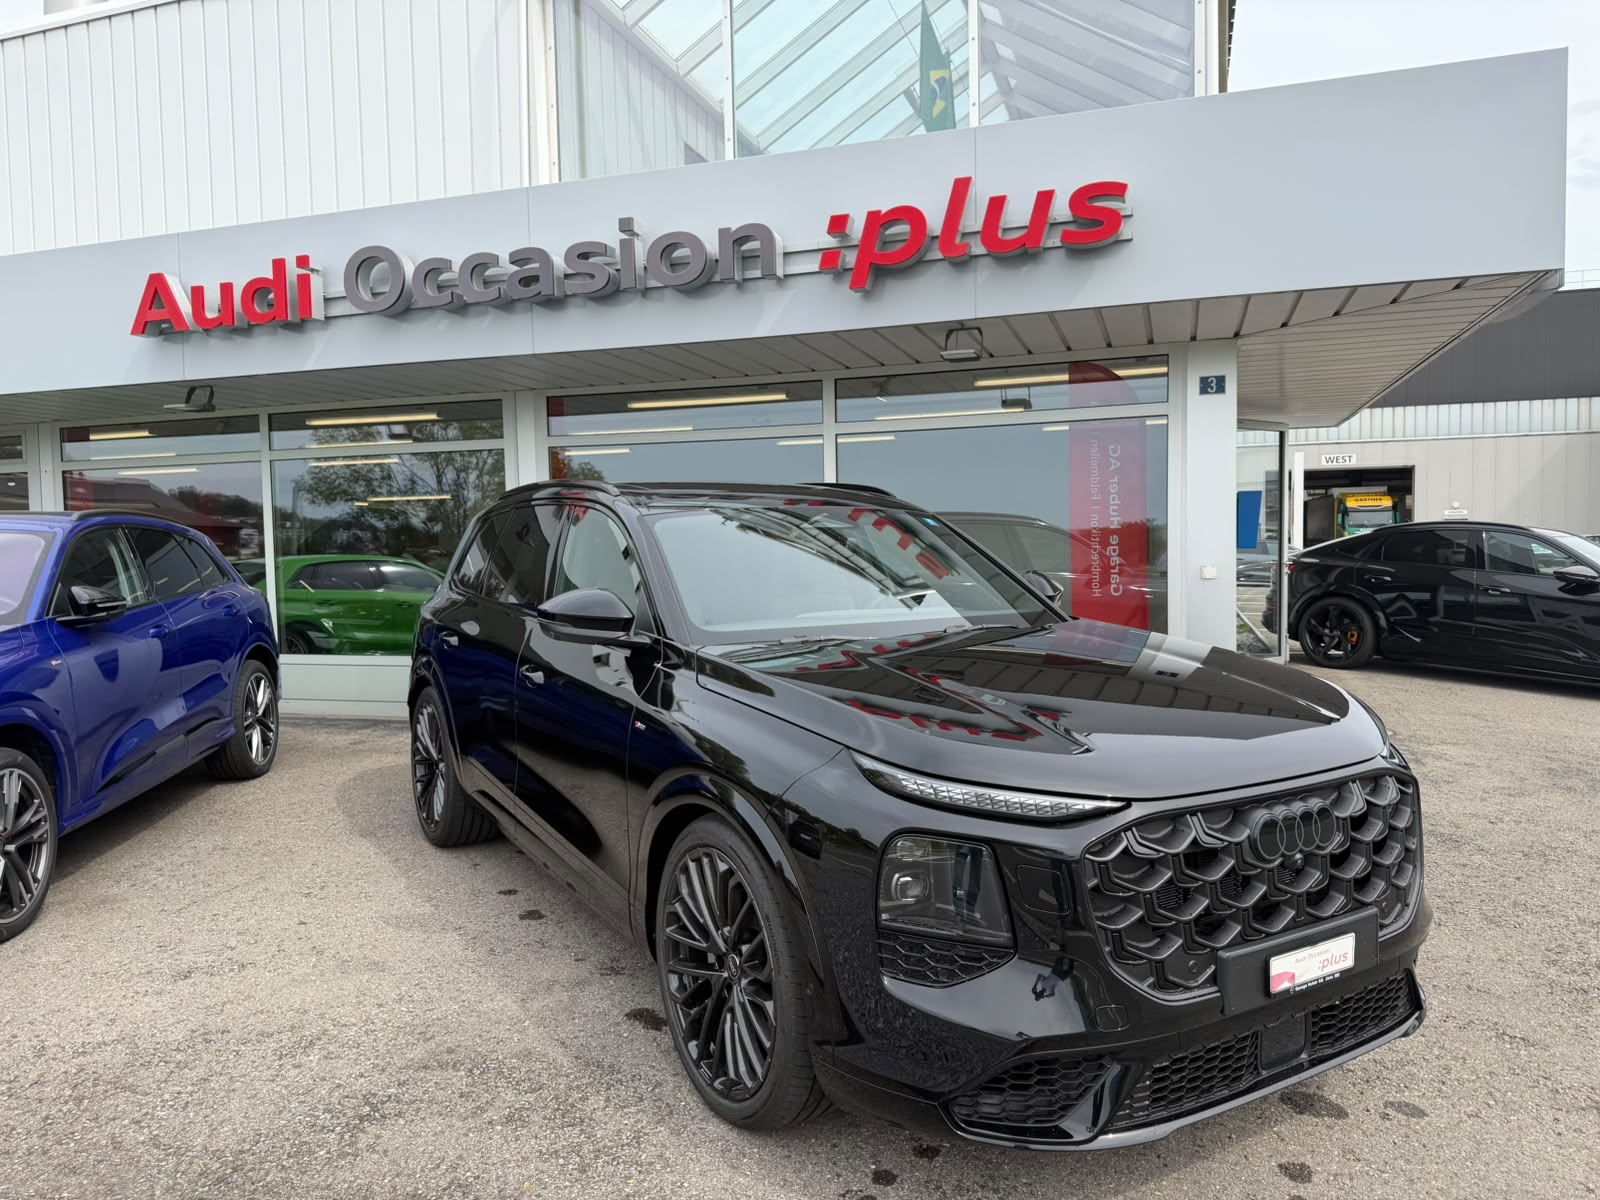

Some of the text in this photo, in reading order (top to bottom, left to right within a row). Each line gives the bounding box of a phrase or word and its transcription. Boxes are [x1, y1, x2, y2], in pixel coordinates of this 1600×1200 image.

[130, 176, 1130, 338] Audi Occasion :plus
[1207, 377, 1217, 393] 3
[1325, 455, 1353, 464] WEST
[1318, 952, 1348, 972] :plus
